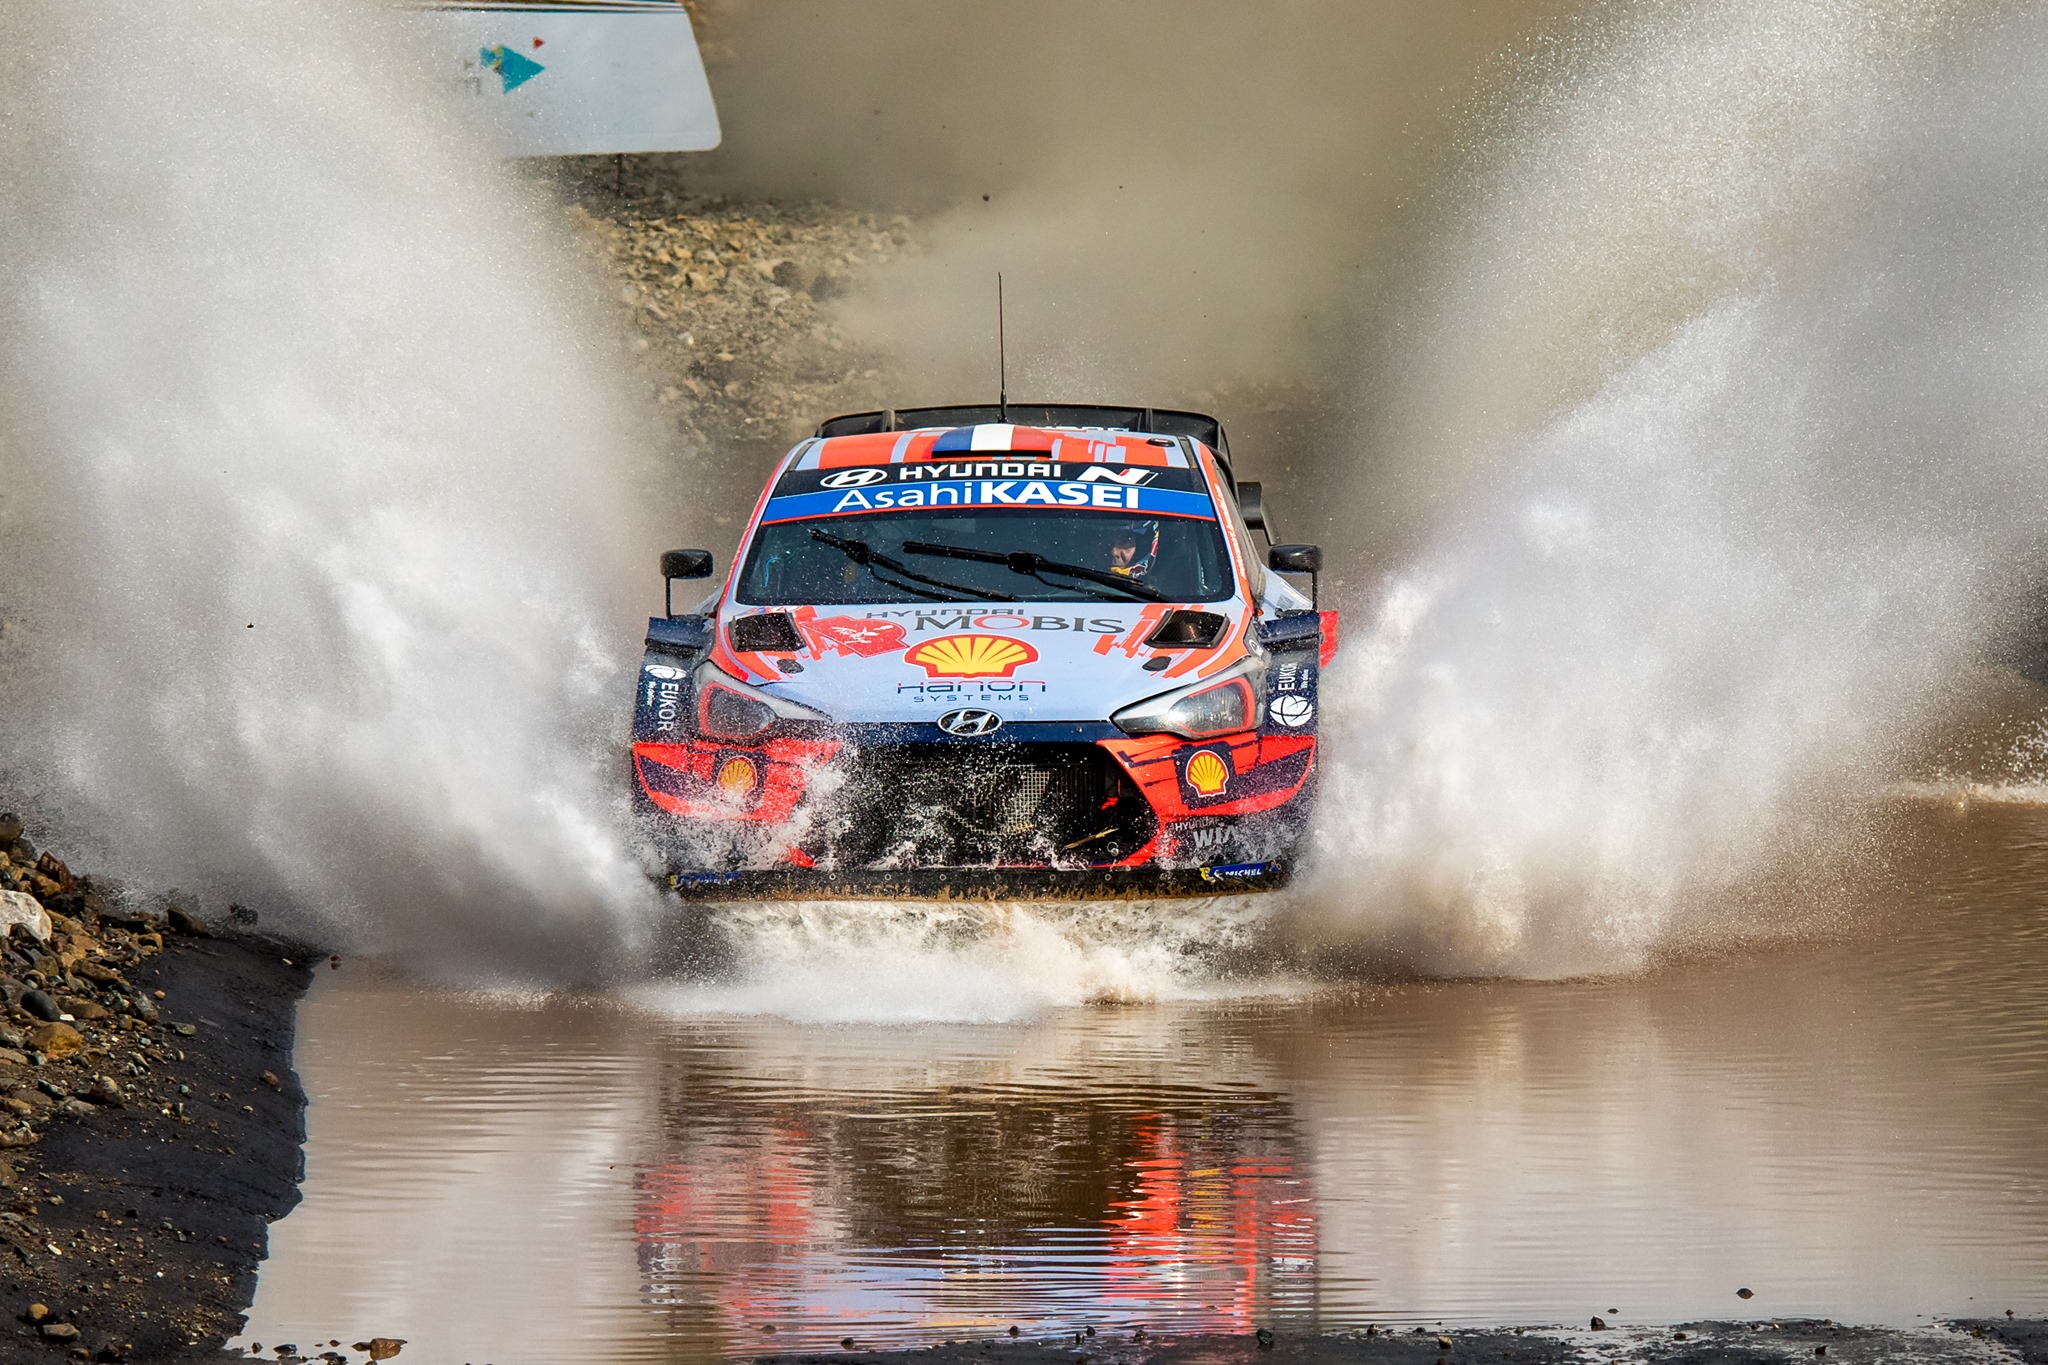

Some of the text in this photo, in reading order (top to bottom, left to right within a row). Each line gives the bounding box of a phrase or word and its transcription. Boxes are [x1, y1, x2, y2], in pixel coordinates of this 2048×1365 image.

[899, 463, 1061, 480] HYUNDAI
[866, 609, 1024, 619] HYUNDAI
[914, 615, 1126, 634] MOBIS
[657, 682, 679, 731] EUKOR
[914, 695, 1029, 703] SYSTEMS
